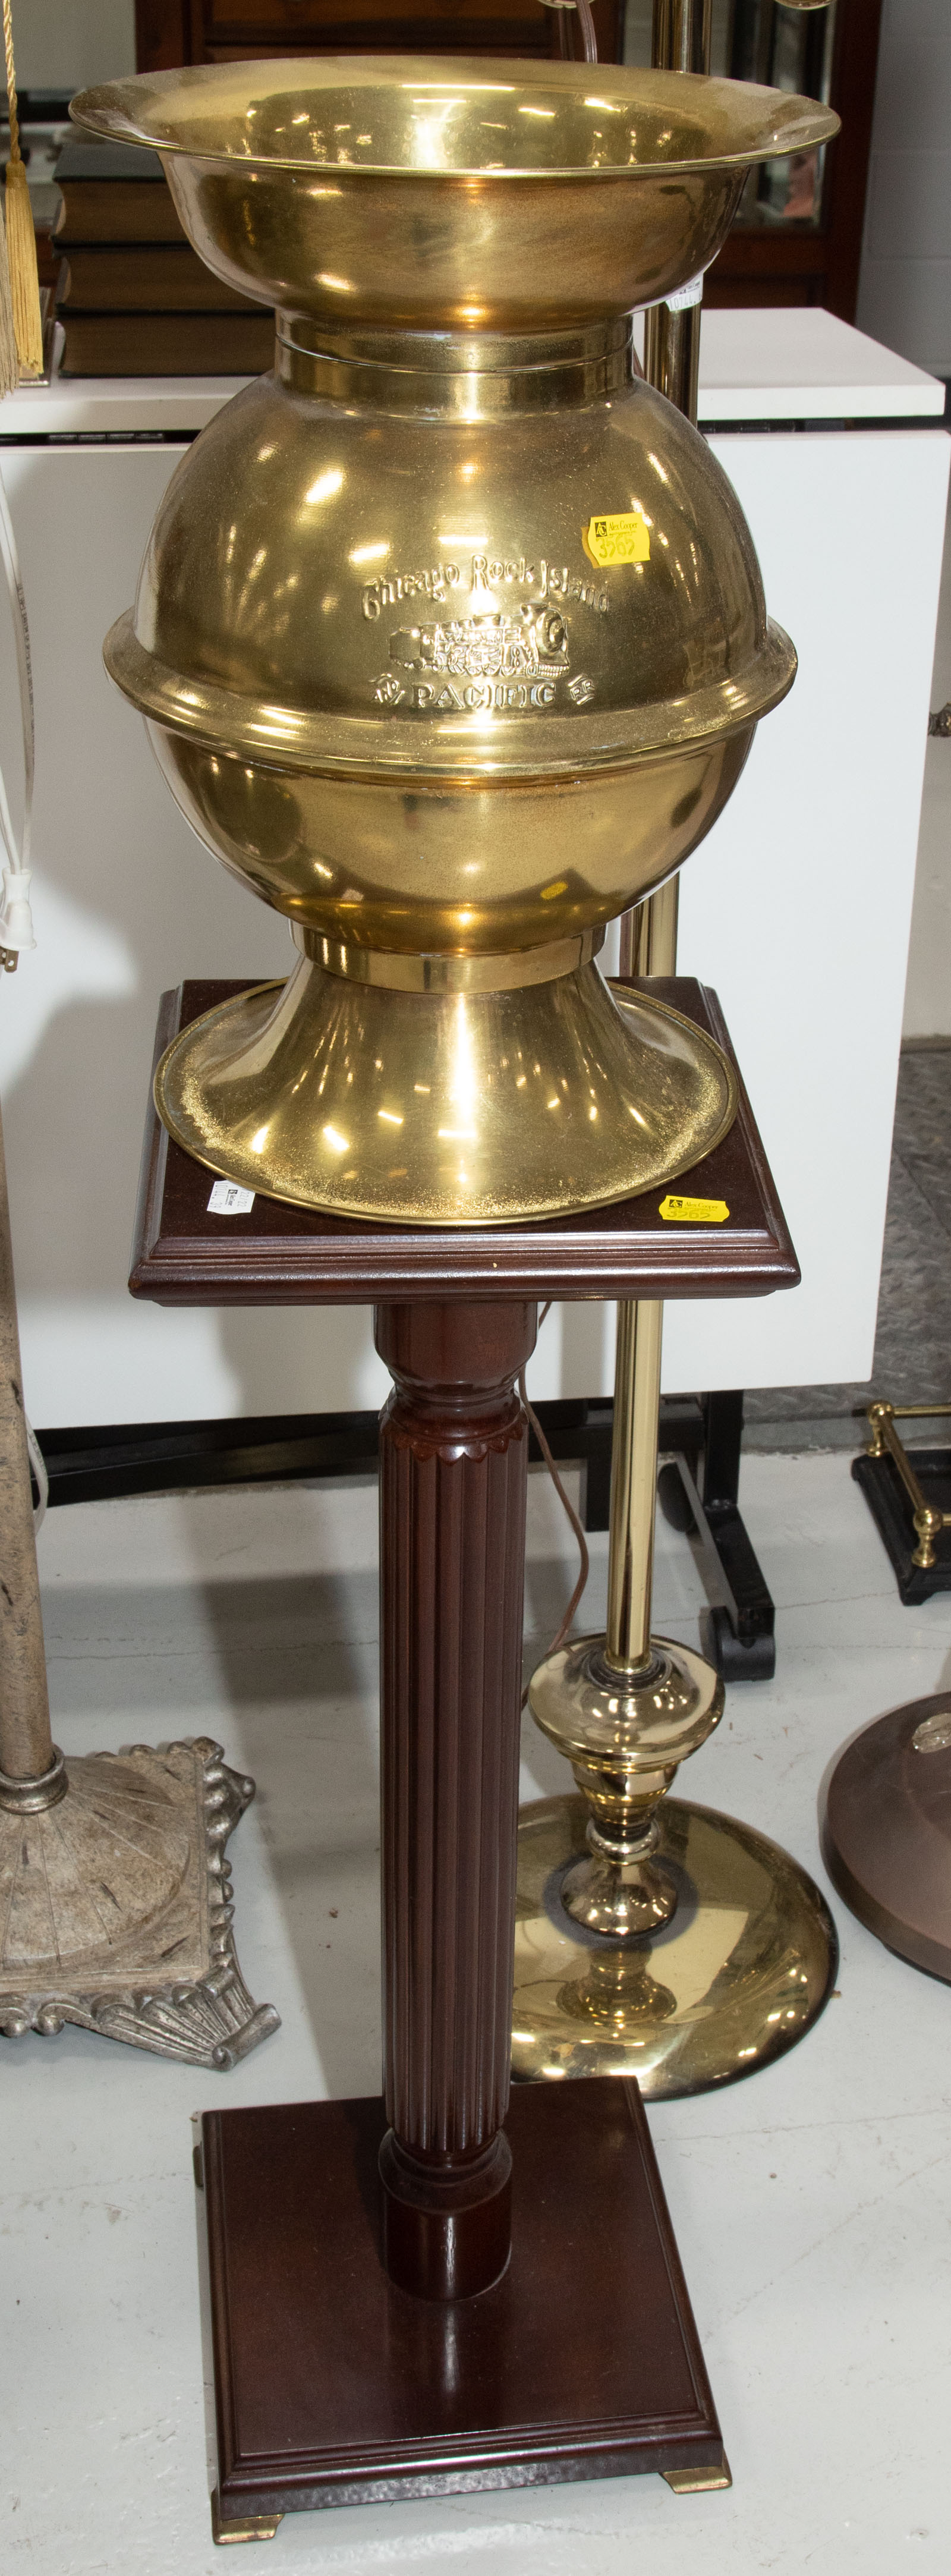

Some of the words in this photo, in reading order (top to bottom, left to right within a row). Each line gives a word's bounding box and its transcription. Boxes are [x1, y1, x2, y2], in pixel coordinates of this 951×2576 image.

[620, 520, 638, 530] Cooper
[596, 534, 635, 558] 3565
[363, 562, 460, 621] Chicago
[471, 555, 534, 592] Rock
[540, 559, 609, 612] Island
[411, 682, 556, 708] PACIFIC
[570, 680, 596, 700] RR
[666, 1208, 711, 1219] 3565
